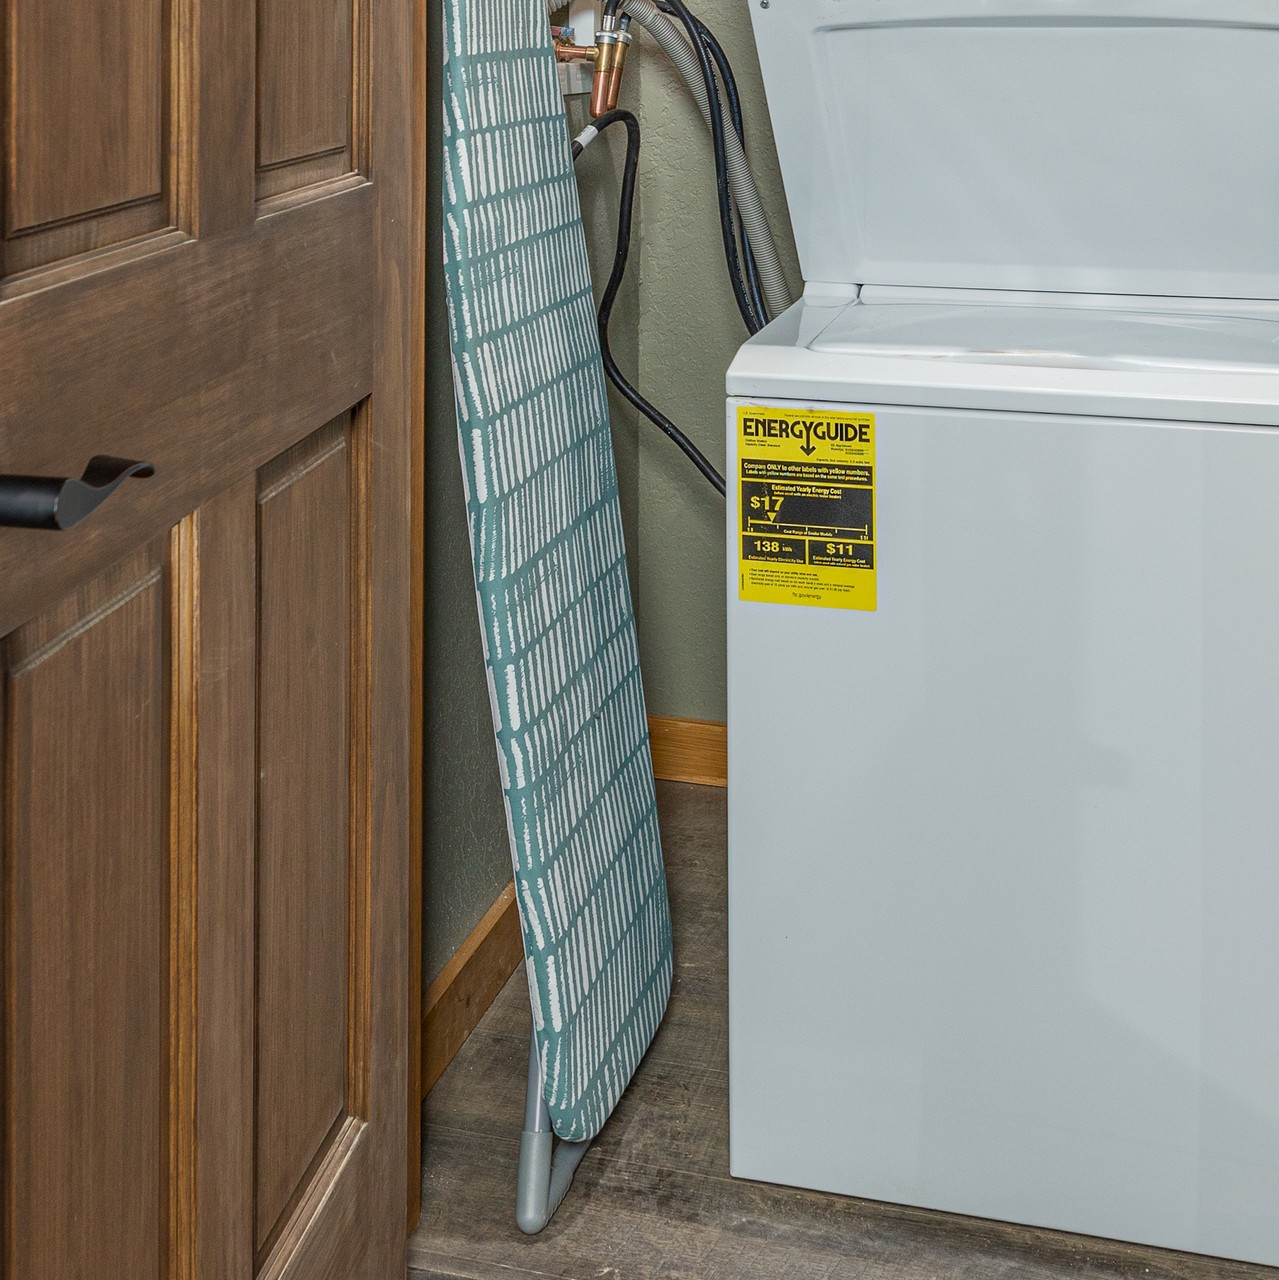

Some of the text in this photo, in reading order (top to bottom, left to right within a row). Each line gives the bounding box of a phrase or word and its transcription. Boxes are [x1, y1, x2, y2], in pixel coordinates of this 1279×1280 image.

[743, 418, 870, 443] ENERGYGUIDE
[829, 467, 845, 475] yellow
[772, 484, 796, 492] Estimated
[797, 485, 811, 493] Yearly
[750, 495, 784, 511] $17
[754, 540, 779, 552] 138
[826, 543, 853, 555] $11
